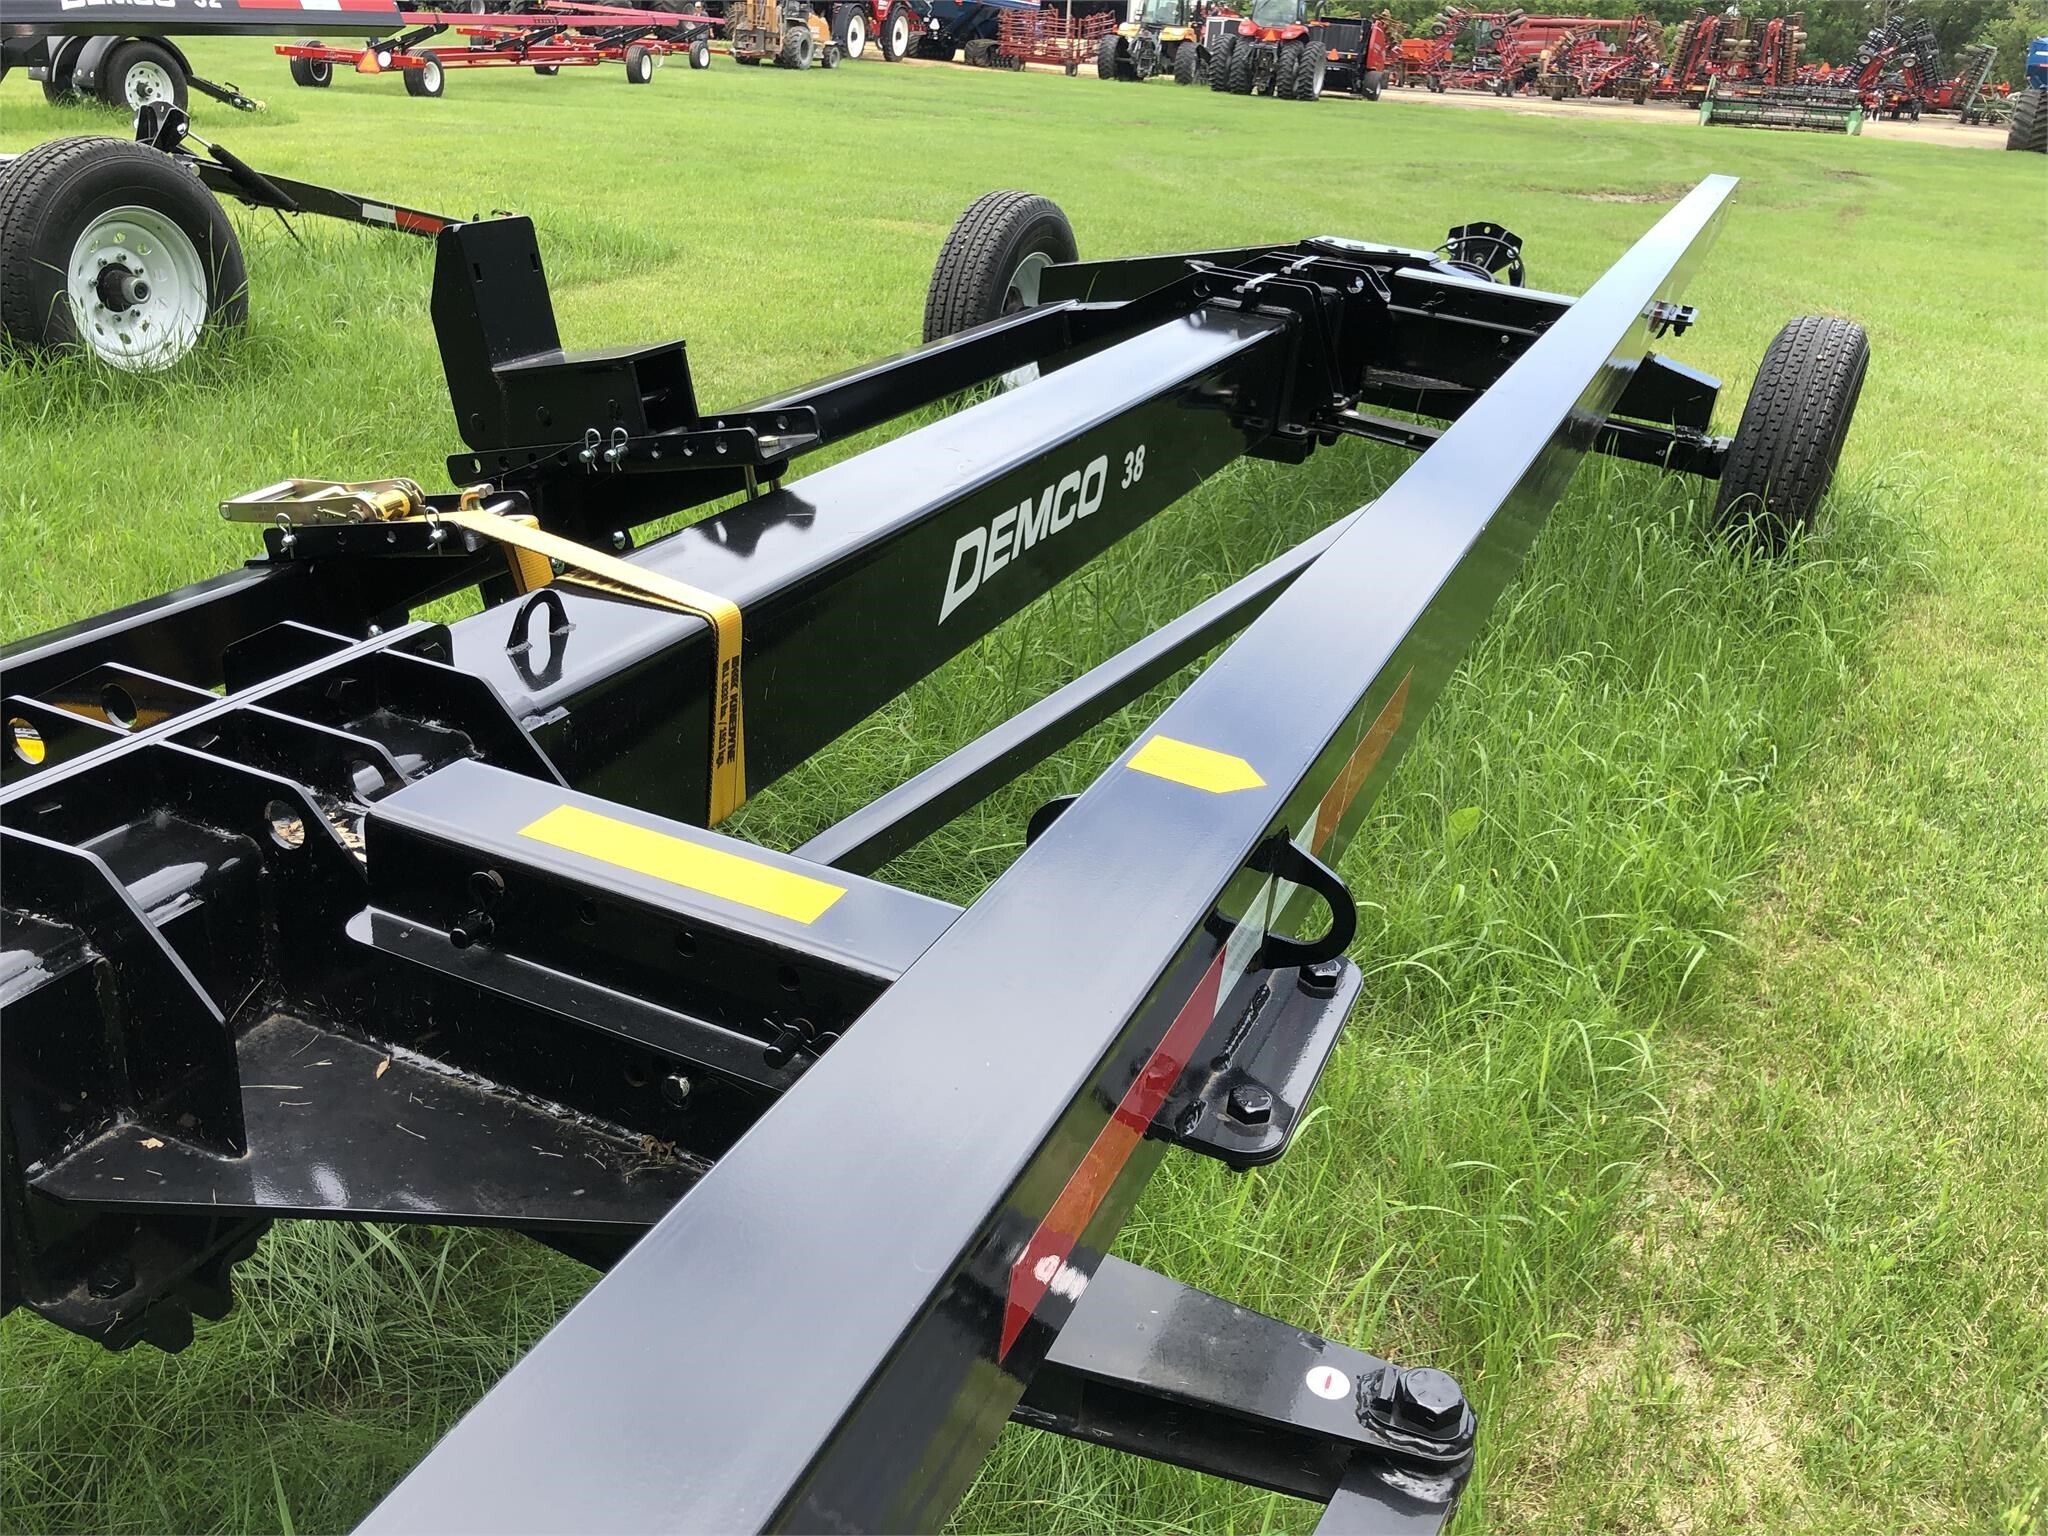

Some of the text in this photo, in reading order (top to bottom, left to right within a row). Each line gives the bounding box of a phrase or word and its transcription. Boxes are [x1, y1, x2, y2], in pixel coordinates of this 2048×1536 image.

[938, 444, 1146, 626] DEMCO 38
[727, 693, 738, 764] KINEDYNE
